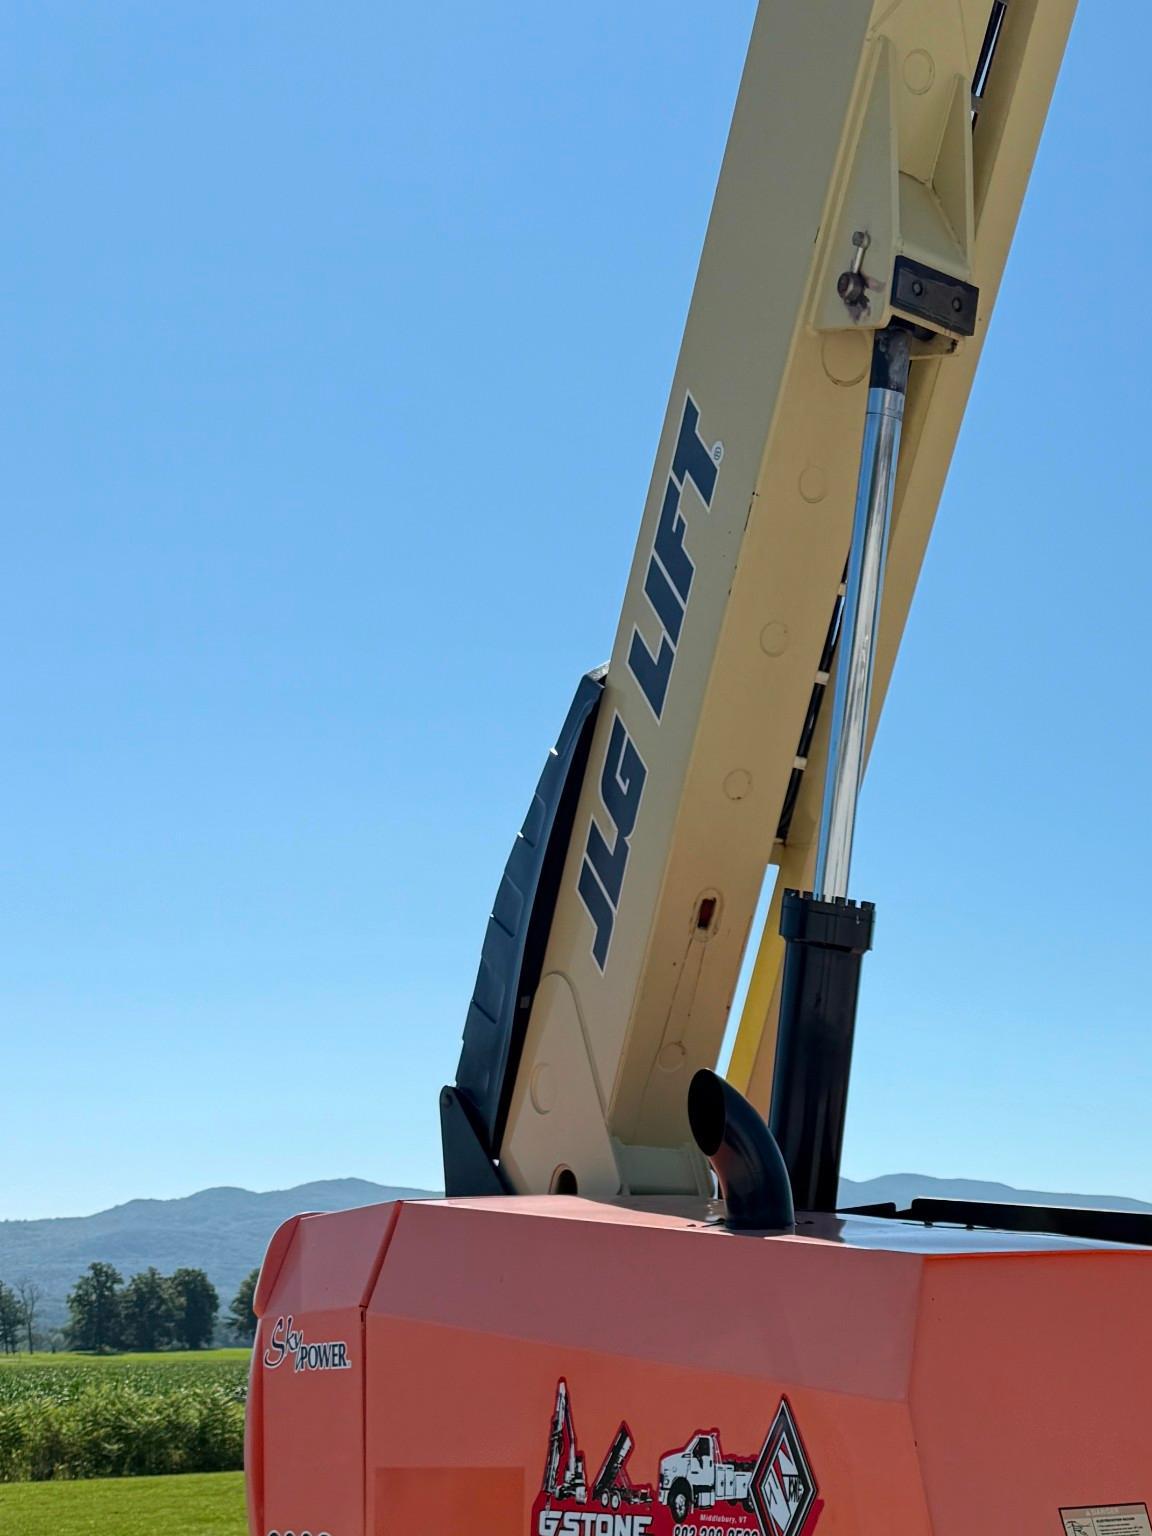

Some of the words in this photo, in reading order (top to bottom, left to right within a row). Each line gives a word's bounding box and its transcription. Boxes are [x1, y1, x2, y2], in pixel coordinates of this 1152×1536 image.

[576, 706, 648, 977] JLG
[626, 389, 720, 726] LIFT
[264, 1315, 303, 1373] Sky
[300, 1342, 348, 1370] POWER
[700, 1513, 737, 1524] Middlebury,
[738, 1515, 747, 1524] VT
